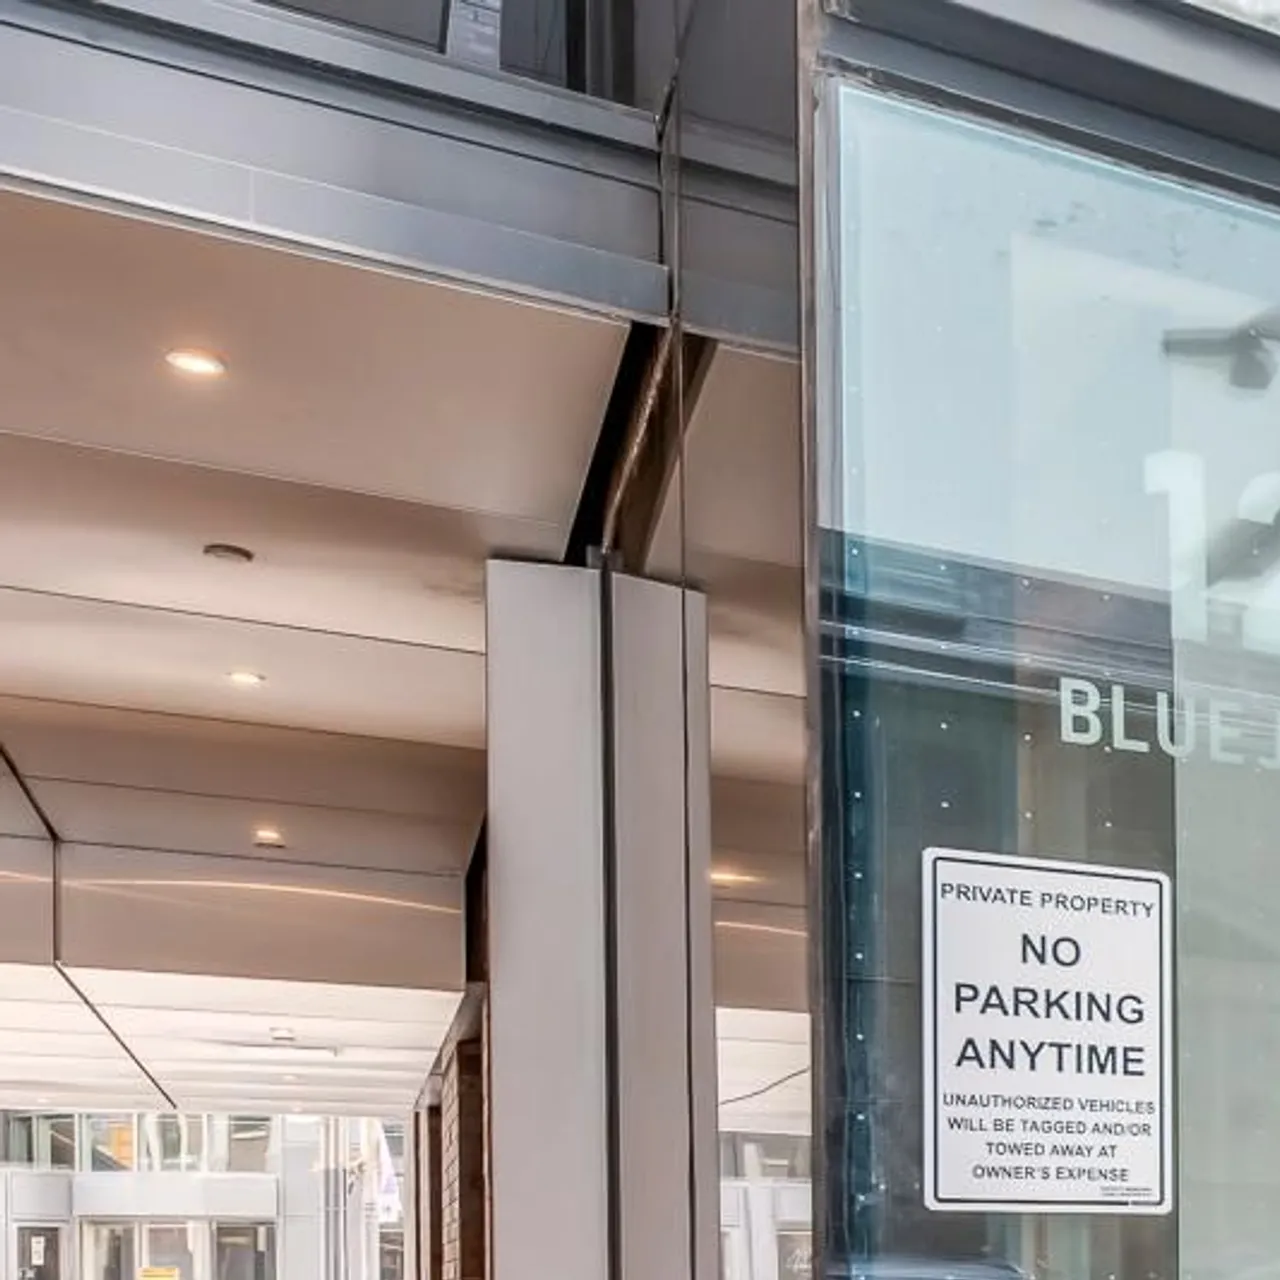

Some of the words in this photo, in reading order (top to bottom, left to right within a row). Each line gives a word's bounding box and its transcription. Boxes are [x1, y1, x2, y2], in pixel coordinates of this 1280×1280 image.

[1058, 676, 1246, 764] BLUE
[941, 882, 1033, 907] PRIVATE
[1041, 892, 1155, 918] PROPERTY
[1021, 933, 1081, 967] NO
[955, 982, 1144, 1024] PARKING
[955, 1037, 1145, 1076] ANYTIME
[943, 1093, 1074, 1111] UNAUTHORIZED
[1078, 1098, 1156, 1115] VEHICLES
[948, 1117, 987, 1132] WILL
[993, 1118, 1015, 1132] BE
[1020, 1120, 1087, 1135] TAGGED
[1091, 1122, 1152, 1137] AND/OR
[986, 1142, 1045, 1156] TOWED
[1049, 1144, 1093, 1158] AWAY
[1097, 1145, 1118, 1158] AT
[972, 1164, 1050, 1180] OWNER'S
[1056, 1166, 1129, 1182] EXPENSE
